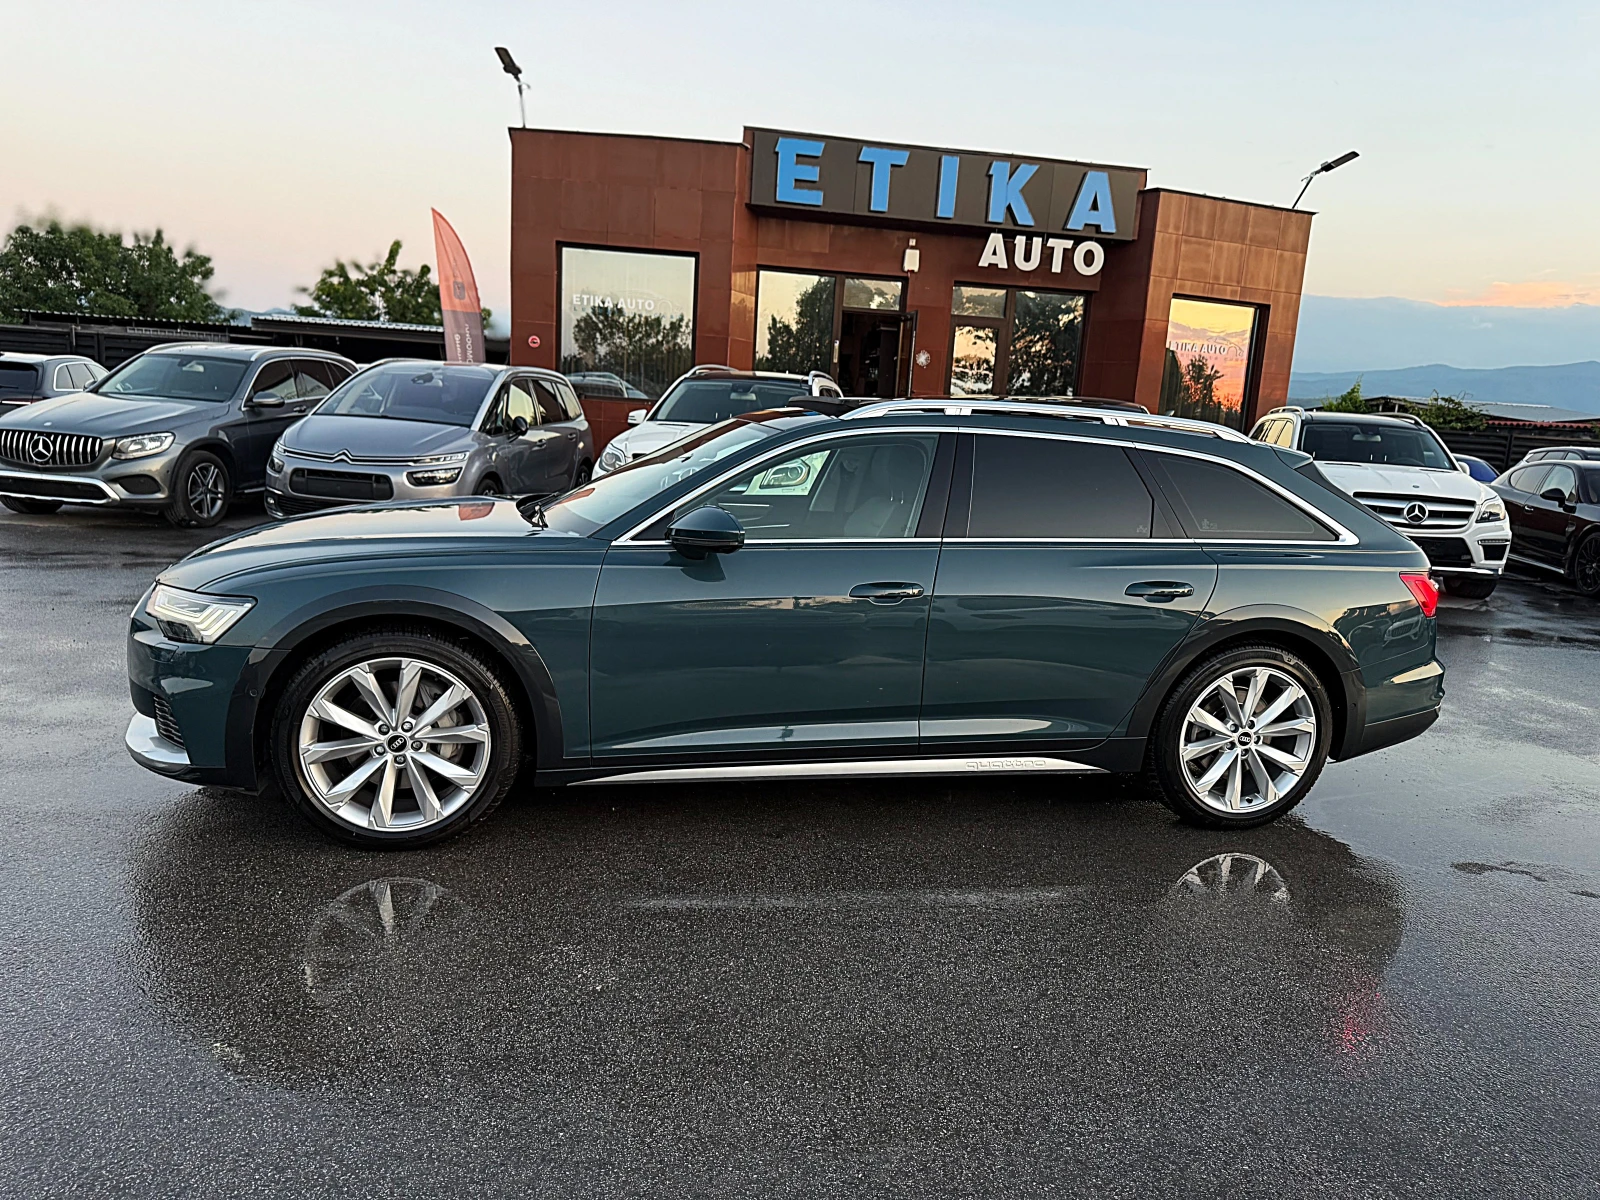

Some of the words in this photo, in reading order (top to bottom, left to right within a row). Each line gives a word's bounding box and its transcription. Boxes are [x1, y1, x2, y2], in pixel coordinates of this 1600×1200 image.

[774, 136, 1116, 234] ETIKA
[979, 232, 1105, 277] AUTO
[572, 293, 614, 308] ETIKA
[617, 297, 655, 311] AUTO
[1200, 343, 1227, 355] AUTO
[965, 760, 1046, 770] quattro
